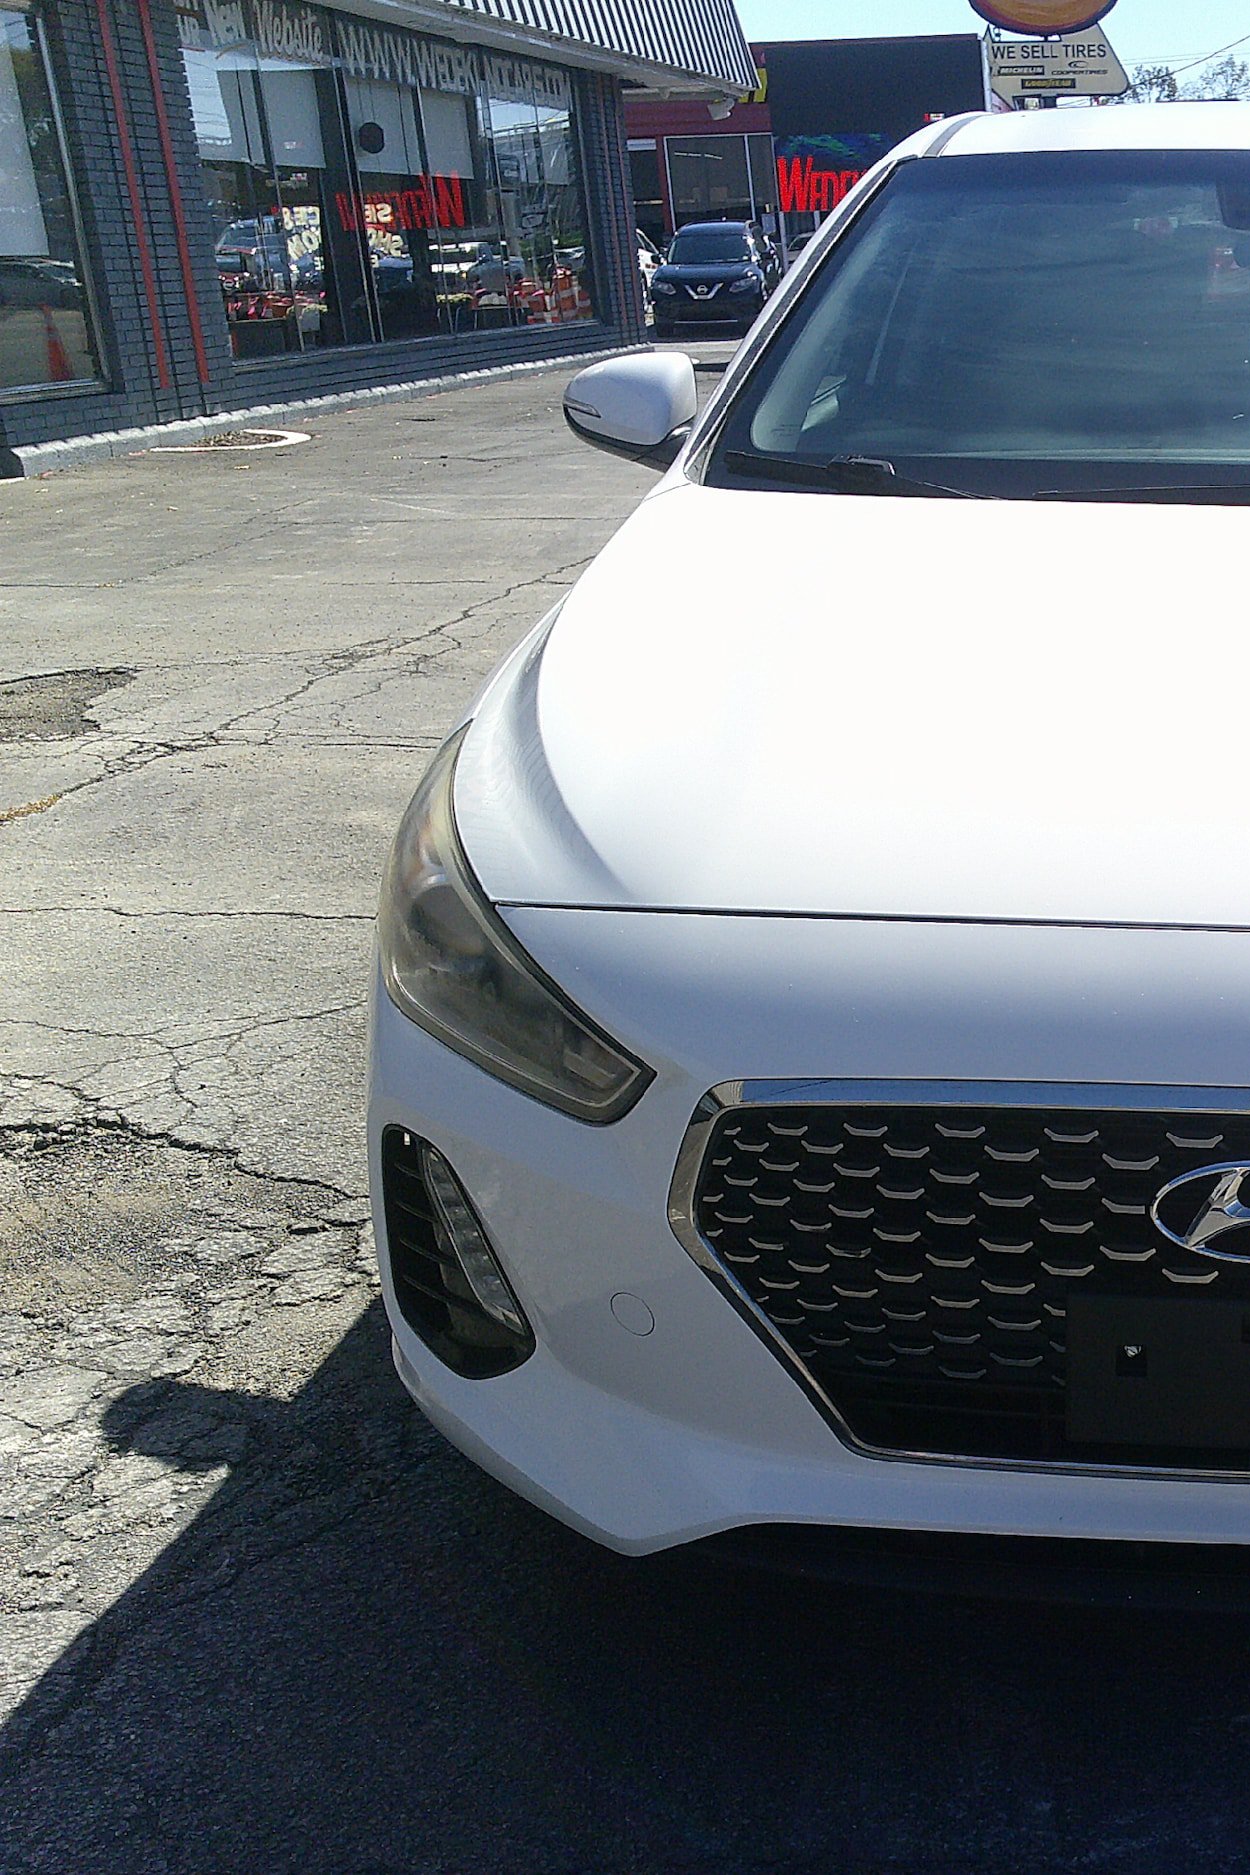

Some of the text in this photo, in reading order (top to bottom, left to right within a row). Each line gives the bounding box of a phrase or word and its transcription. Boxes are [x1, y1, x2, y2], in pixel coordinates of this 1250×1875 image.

[252, 0, 325, 60] Website
[991, 43, 1107, 60] WE SELL TIRES
[1000, 66, 1044, 76] MICHELIN
